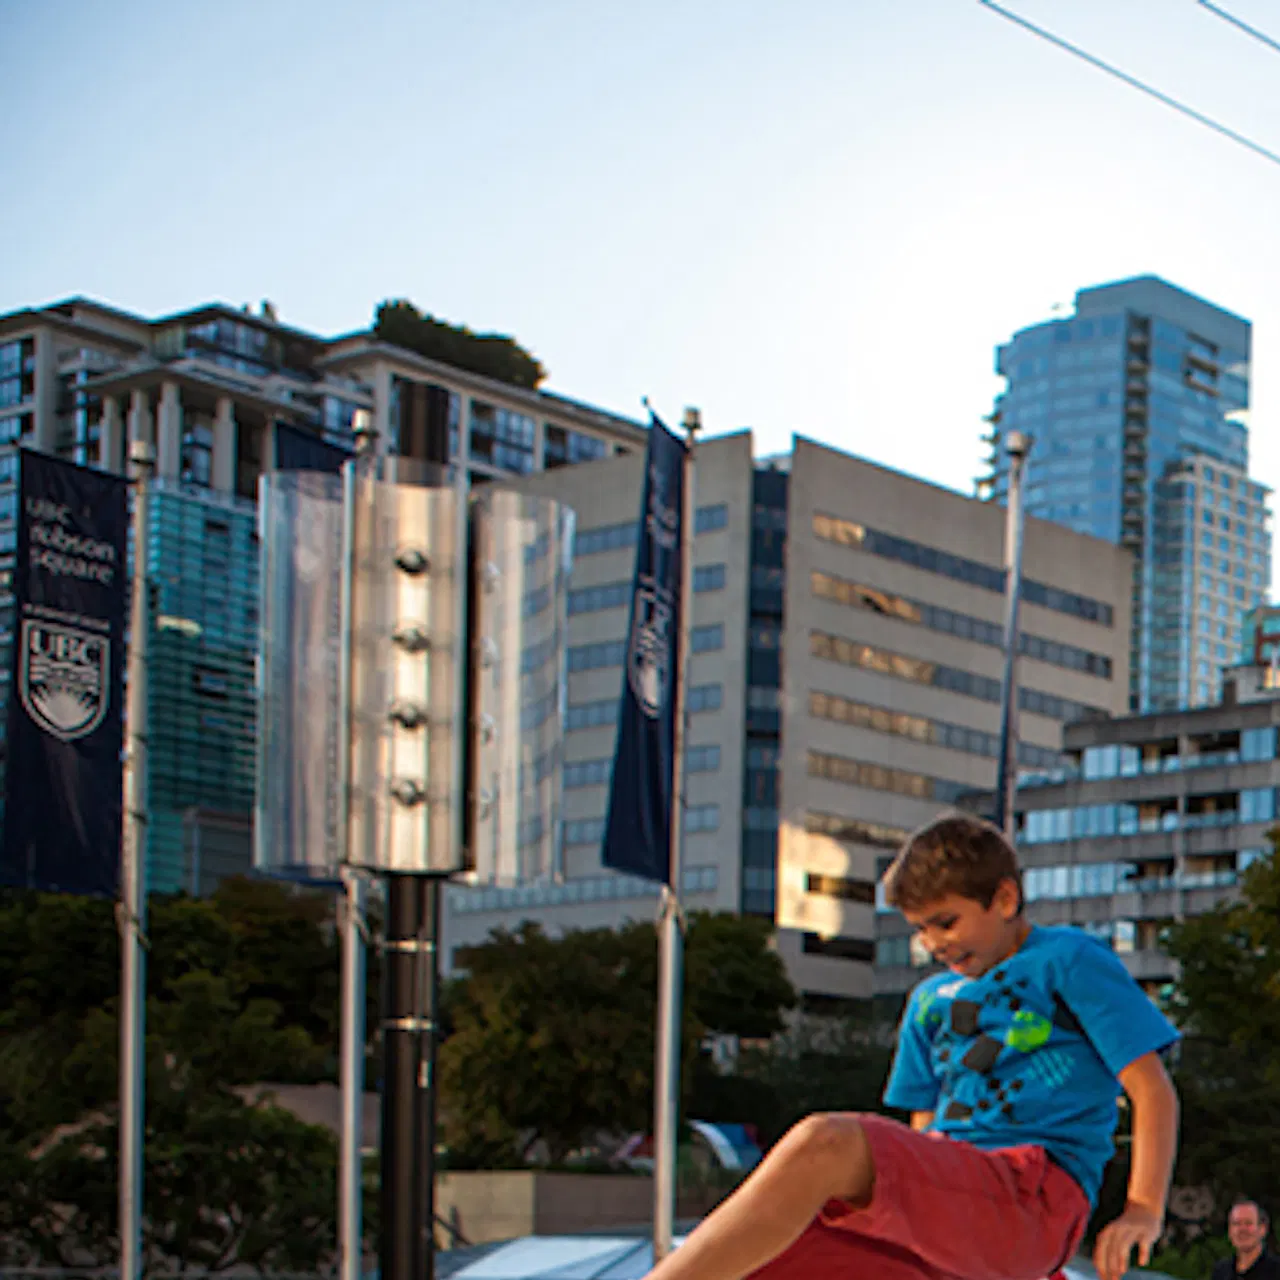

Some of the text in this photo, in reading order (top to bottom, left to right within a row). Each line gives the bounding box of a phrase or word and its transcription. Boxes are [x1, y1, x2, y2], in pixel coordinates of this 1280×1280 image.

[29, 523, 115, 562] robson
[29, 547, 115, 585] square
[30, 627, 101, 667] UBC
